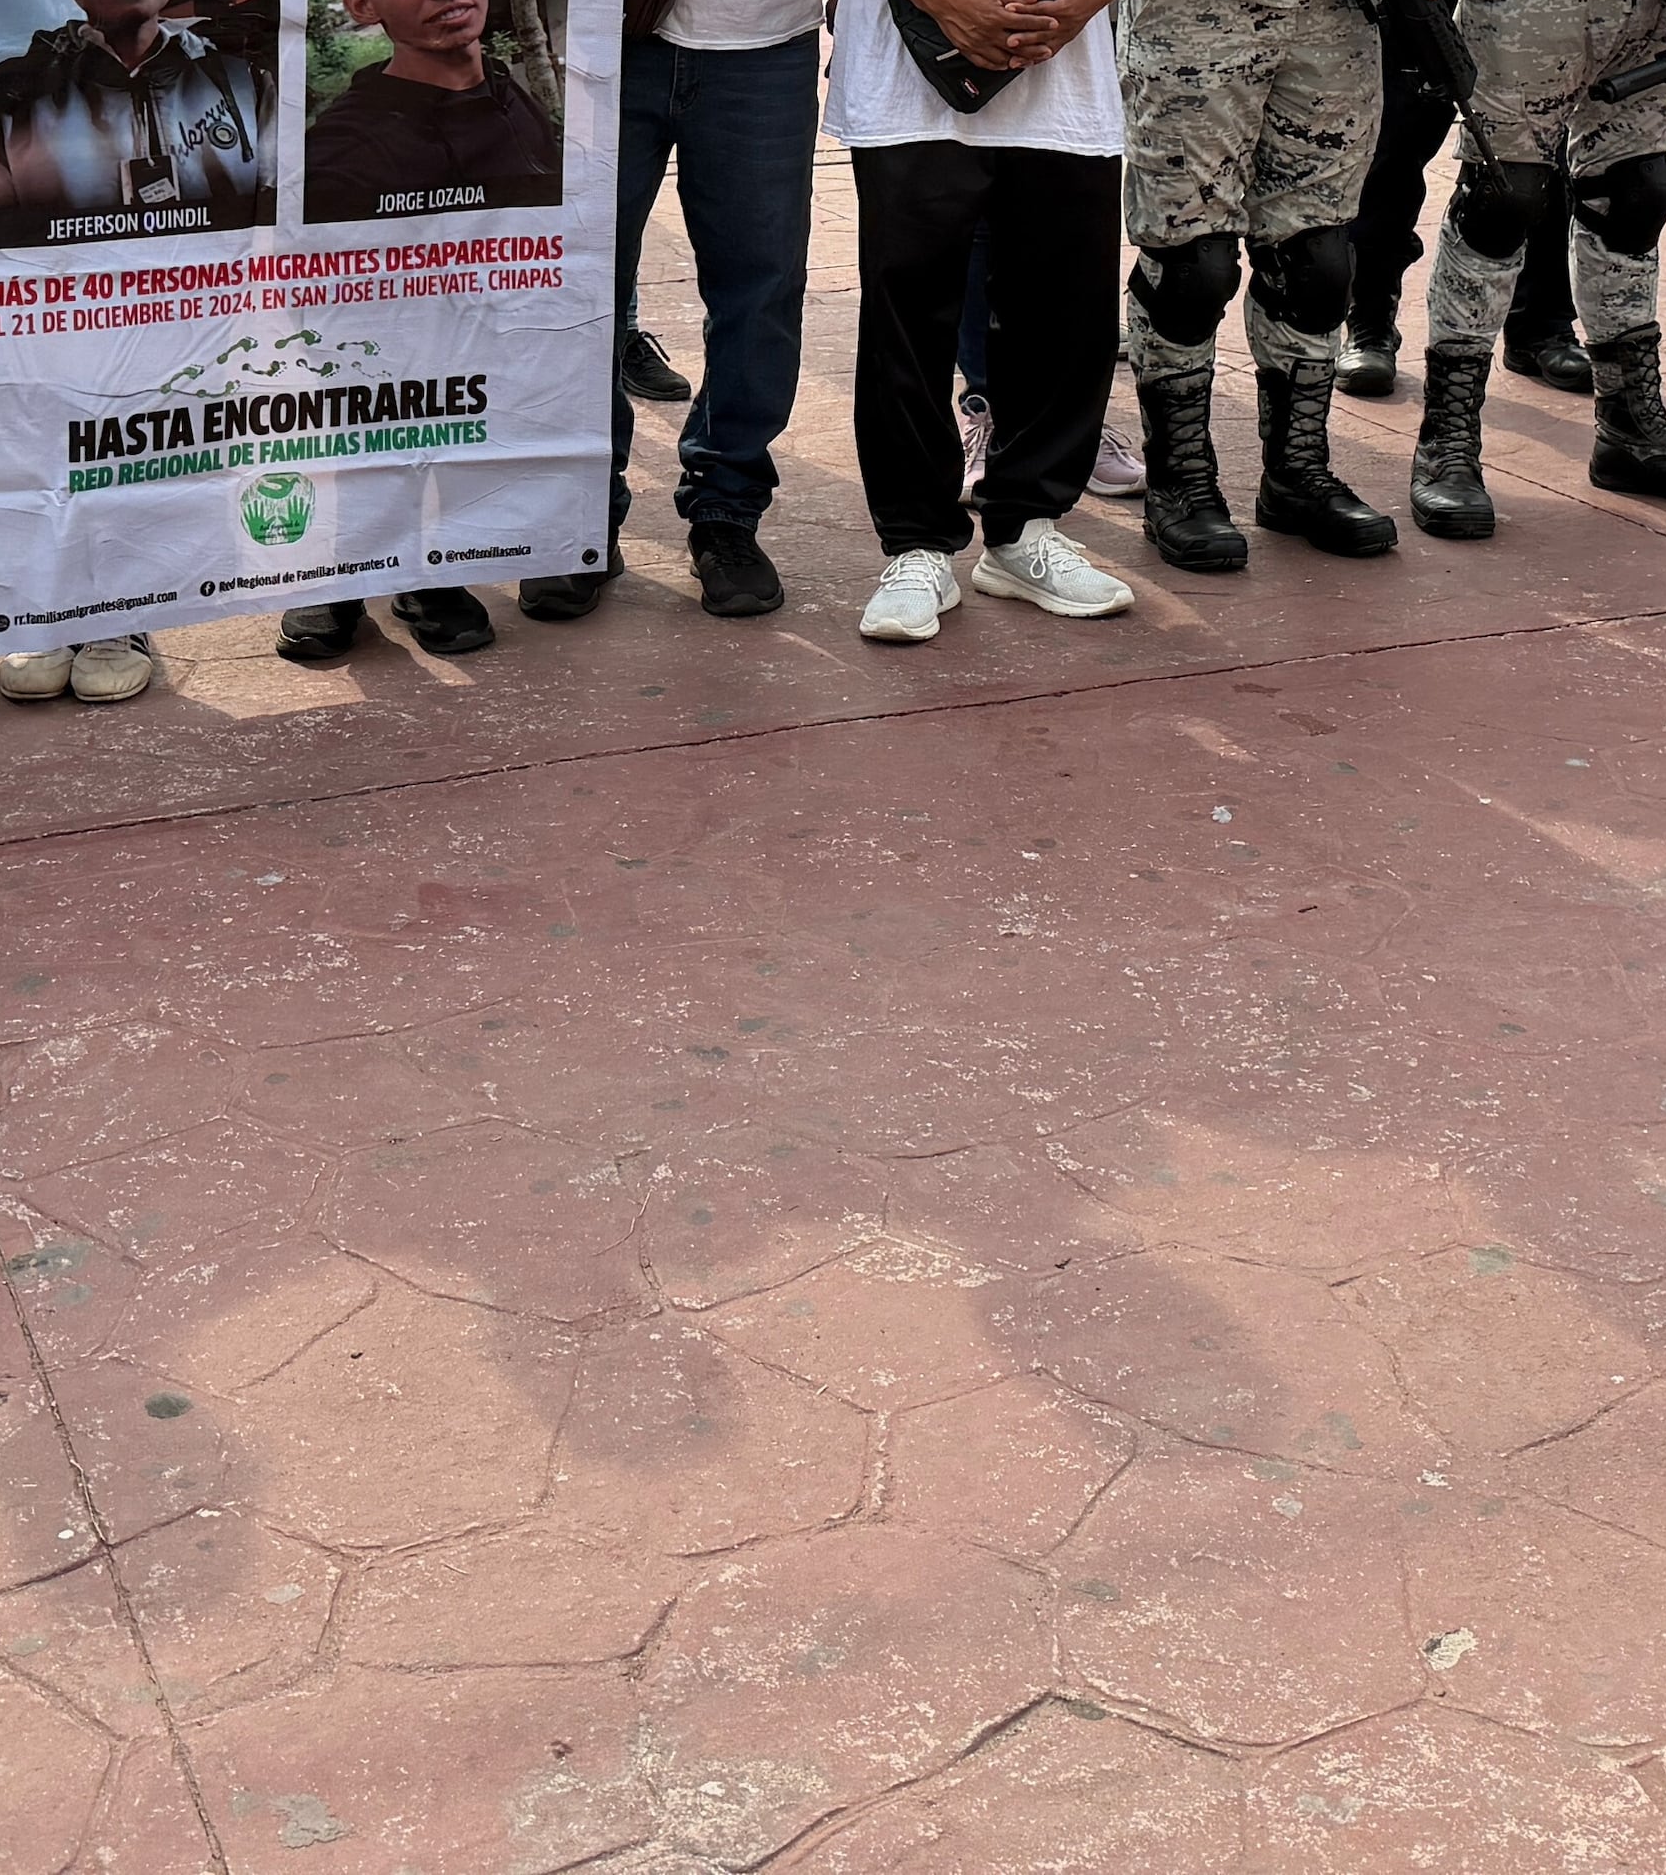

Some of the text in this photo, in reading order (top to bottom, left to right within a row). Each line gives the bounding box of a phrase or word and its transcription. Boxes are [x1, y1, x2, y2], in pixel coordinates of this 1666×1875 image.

[47, 206, 212, 240] JEFFERSON QUINDIL
[376, 185, 486, 214] JORGE LOZADA
[44, 277, 76, 304] DE
[82, 273, 114, 300] 40
[120, 260, 243, 297] PERSONAS
[248, 248, 380, 283] MIGRANTES
[385, 235, 564, 272] DESAPARECIDAS
[11, 313, 36, 336] 21
[42, 311, 68, 334] DE
[73, 300, 175, 331] DICIEMBRE
[179, 297, 203, 321] DE
[208, 290, 257, 317] 2024,
[261, 287, 285, 310] EN
[291, 284, 327, 308] SAN
[331, 277, 374, 305] JOSÉ
[379, 278, 398, 301] EL
[403, 271, 484, 298] HUEYATE,
[488, 266, 563, 291] CHIAPAS
[68, 374, 488, 464] HASTA ENCONTRARLES
[69, 419, 487, 494] RED REGIONAL DE FAMILIAS MIGRANTES
[219, 556, 400, 593] Red Regional de Familias Migrantes CA
[14, 591, 178, 626] rr.familiasmigrantes@gmail.com
